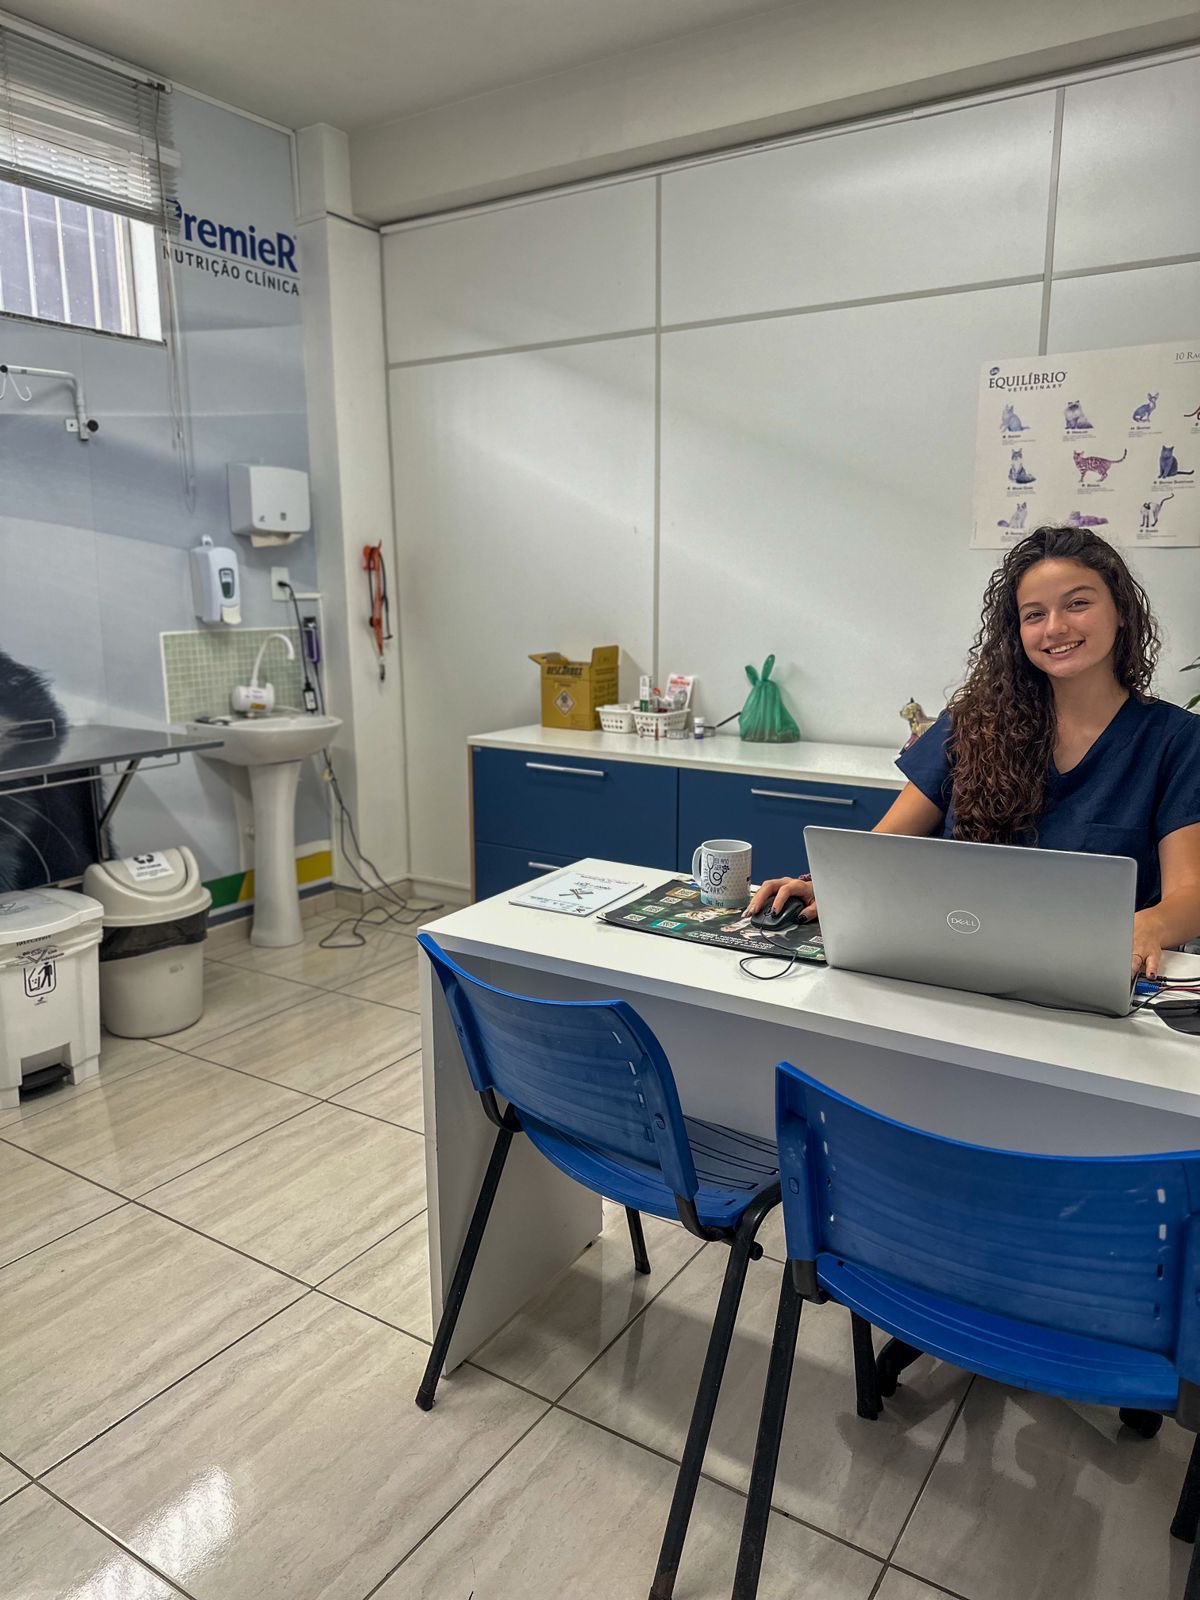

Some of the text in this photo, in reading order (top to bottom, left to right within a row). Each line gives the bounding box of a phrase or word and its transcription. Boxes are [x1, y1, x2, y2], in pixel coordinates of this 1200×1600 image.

[245, 269, 299, 296] CLÍNICA
[1175, 351, 1185, 360] 10
[989, 372, 1066, 389] EQUILÍBRIO
[1008, 384, 1062, 392] VETERINARY
[951, 918, 977, 926] DELL
